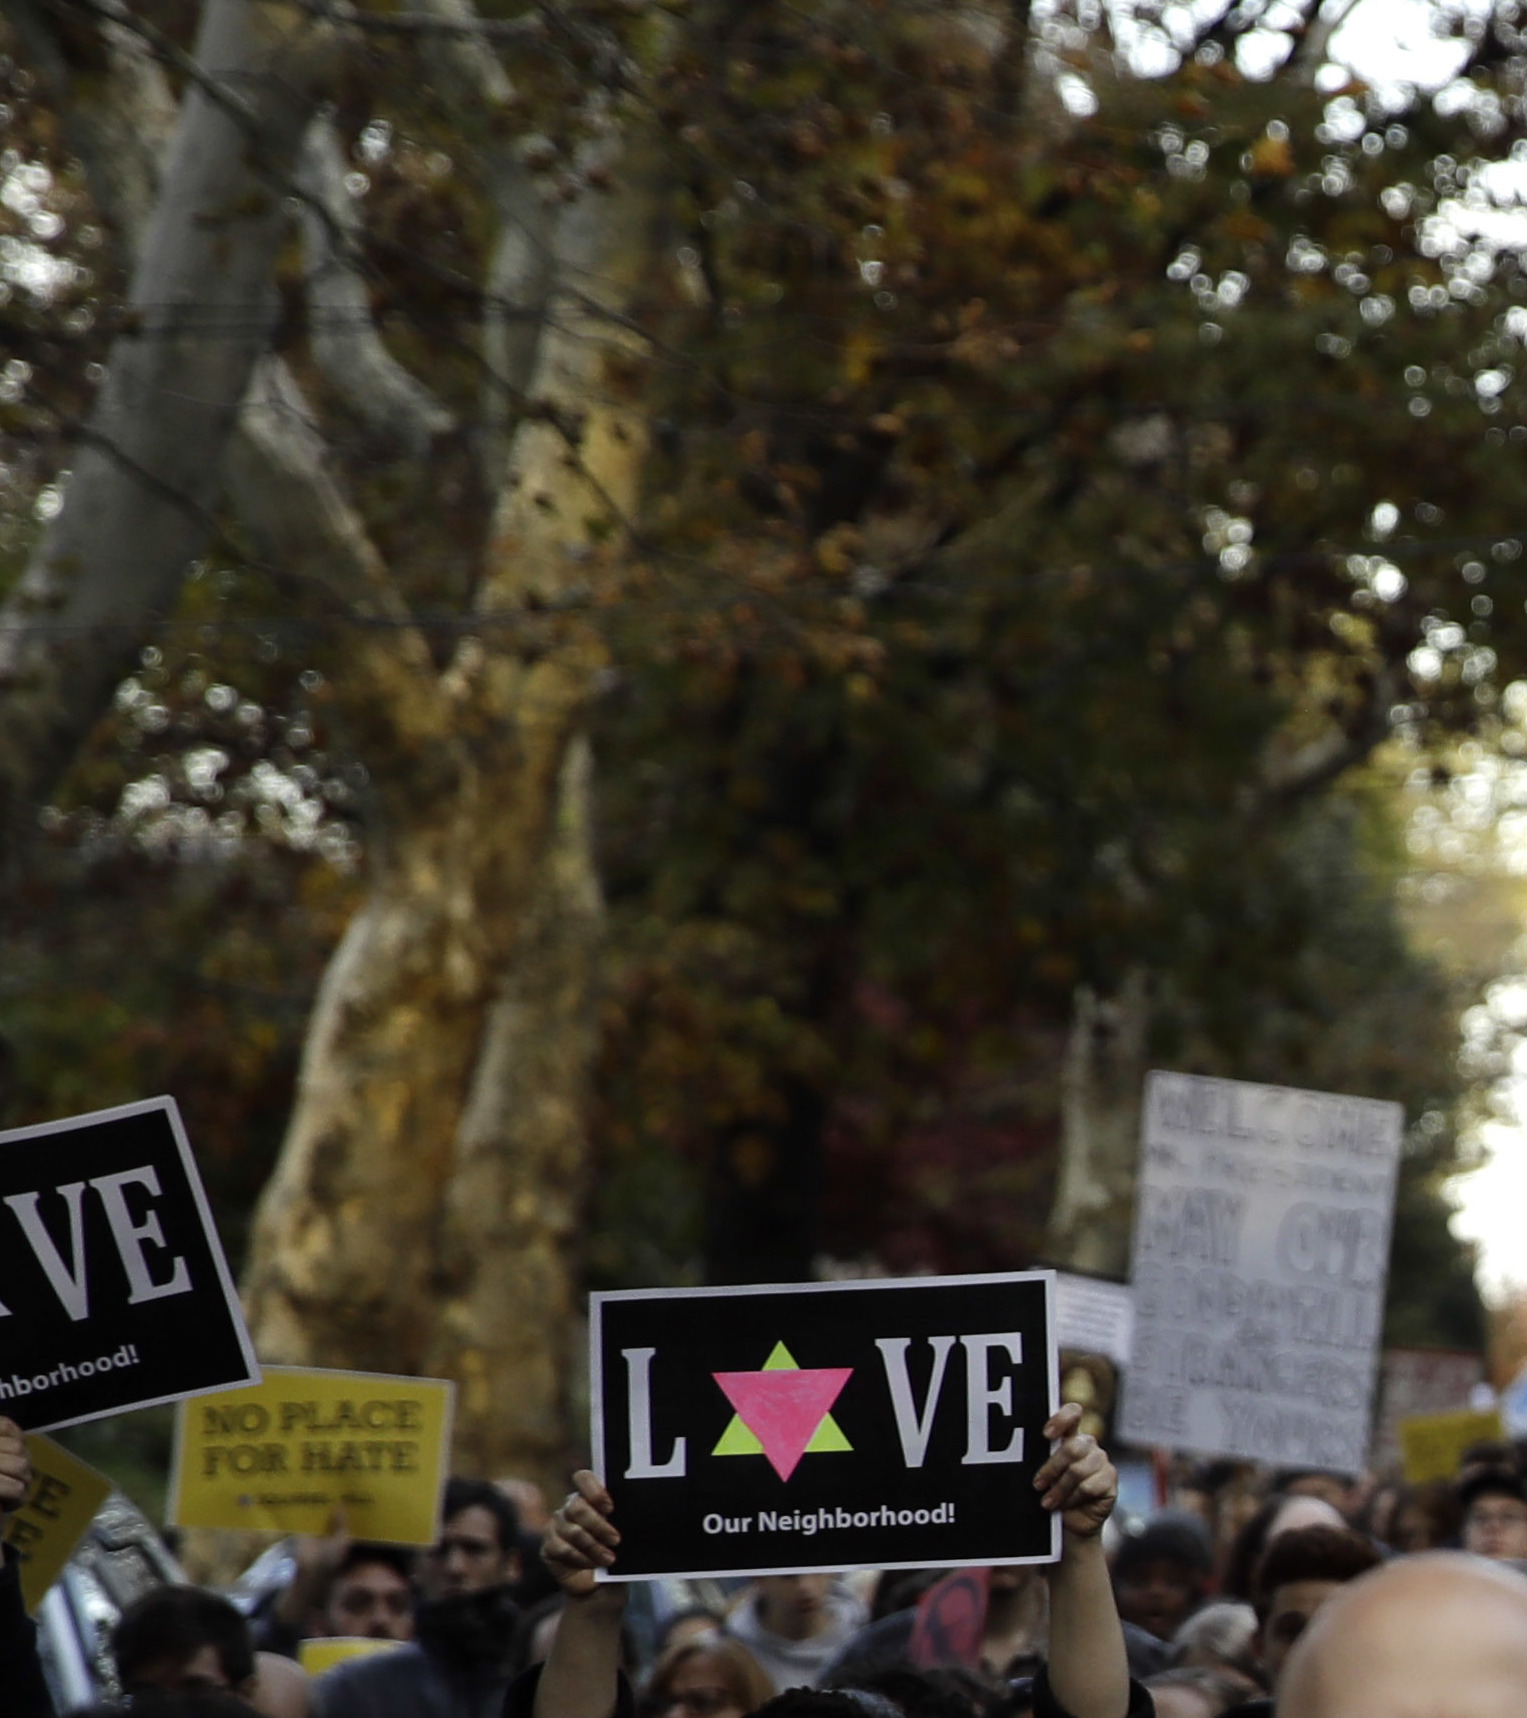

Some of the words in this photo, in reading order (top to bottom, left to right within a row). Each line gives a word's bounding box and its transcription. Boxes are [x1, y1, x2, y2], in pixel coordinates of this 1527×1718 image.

[203, 1403, 270, 1436] NO
[279, 1400, 422, 1432] PLACE
[203, 1443, 288, 1477] FOR
[301, 1440, 420, 1474] HATE
[702, 1513, 752, 1535] Our
[758, 1502, 956, 1535] Neighborhood!
